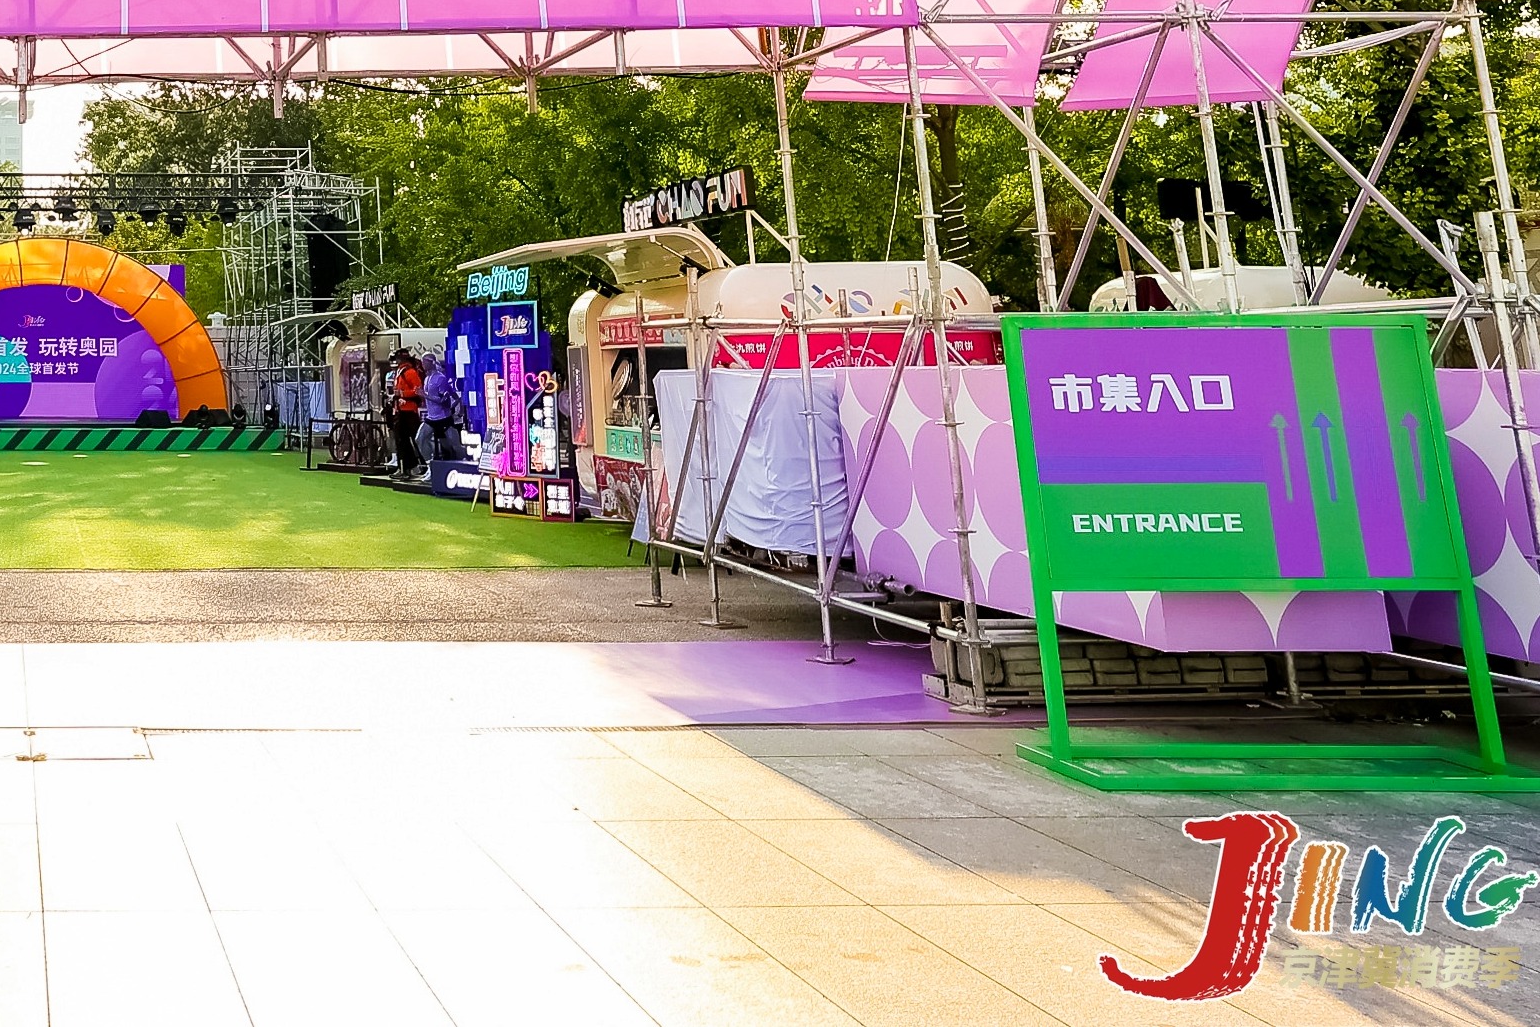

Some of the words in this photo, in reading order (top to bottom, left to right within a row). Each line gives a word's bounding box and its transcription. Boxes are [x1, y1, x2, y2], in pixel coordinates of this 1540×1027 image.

[467, 266, 529, 299] Beijing
[39, 338, 118, 357] 玩转奥园
[1049, 374, 1234, 413] 市集入口
[1072, 512, 1244, 534] ENTRANCE
